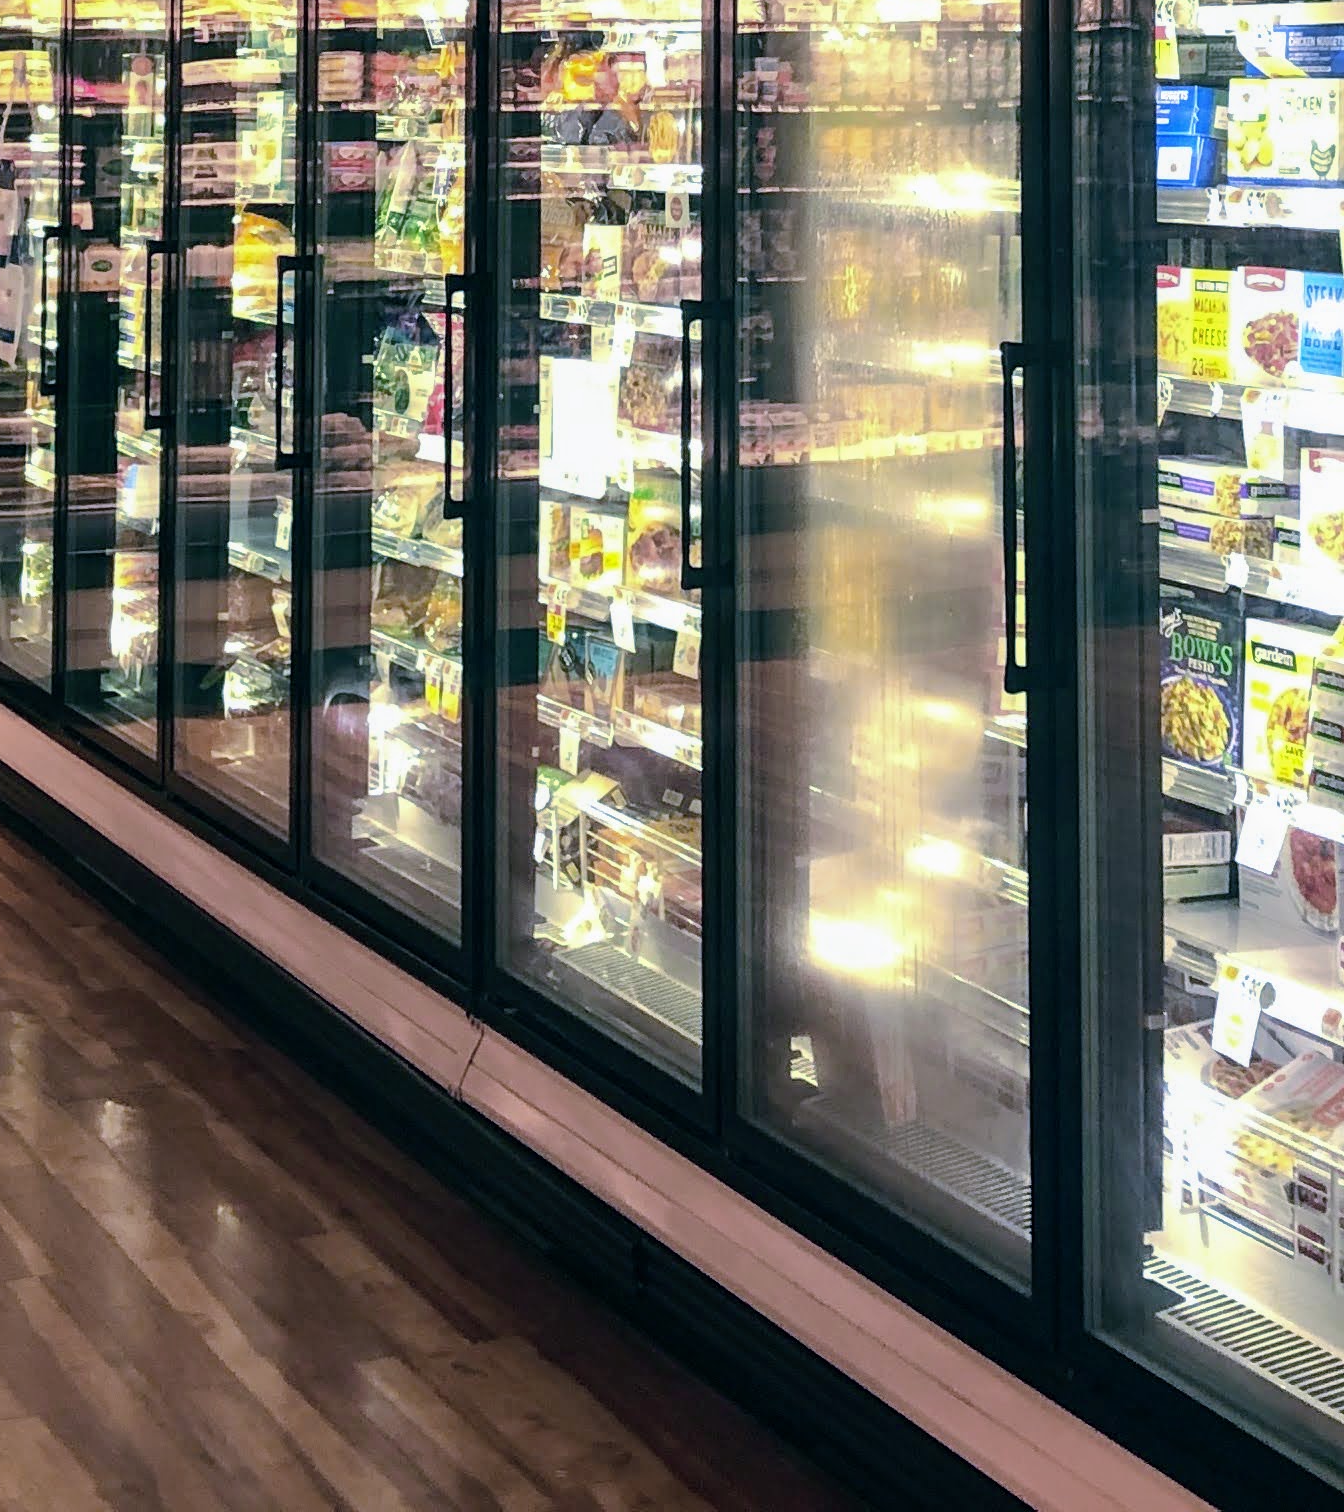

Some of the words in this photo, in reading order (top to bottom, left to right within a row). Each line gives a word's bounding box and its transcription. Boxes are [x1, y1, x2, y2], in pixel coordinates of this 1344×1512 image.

[1192, 327, 1228, 347] CHEESE
[1170, 632, 1233, 676] BOWLS
[1254, 644, 1294, 667] gardein
[1188, 658, 1215, 674] PESTO
